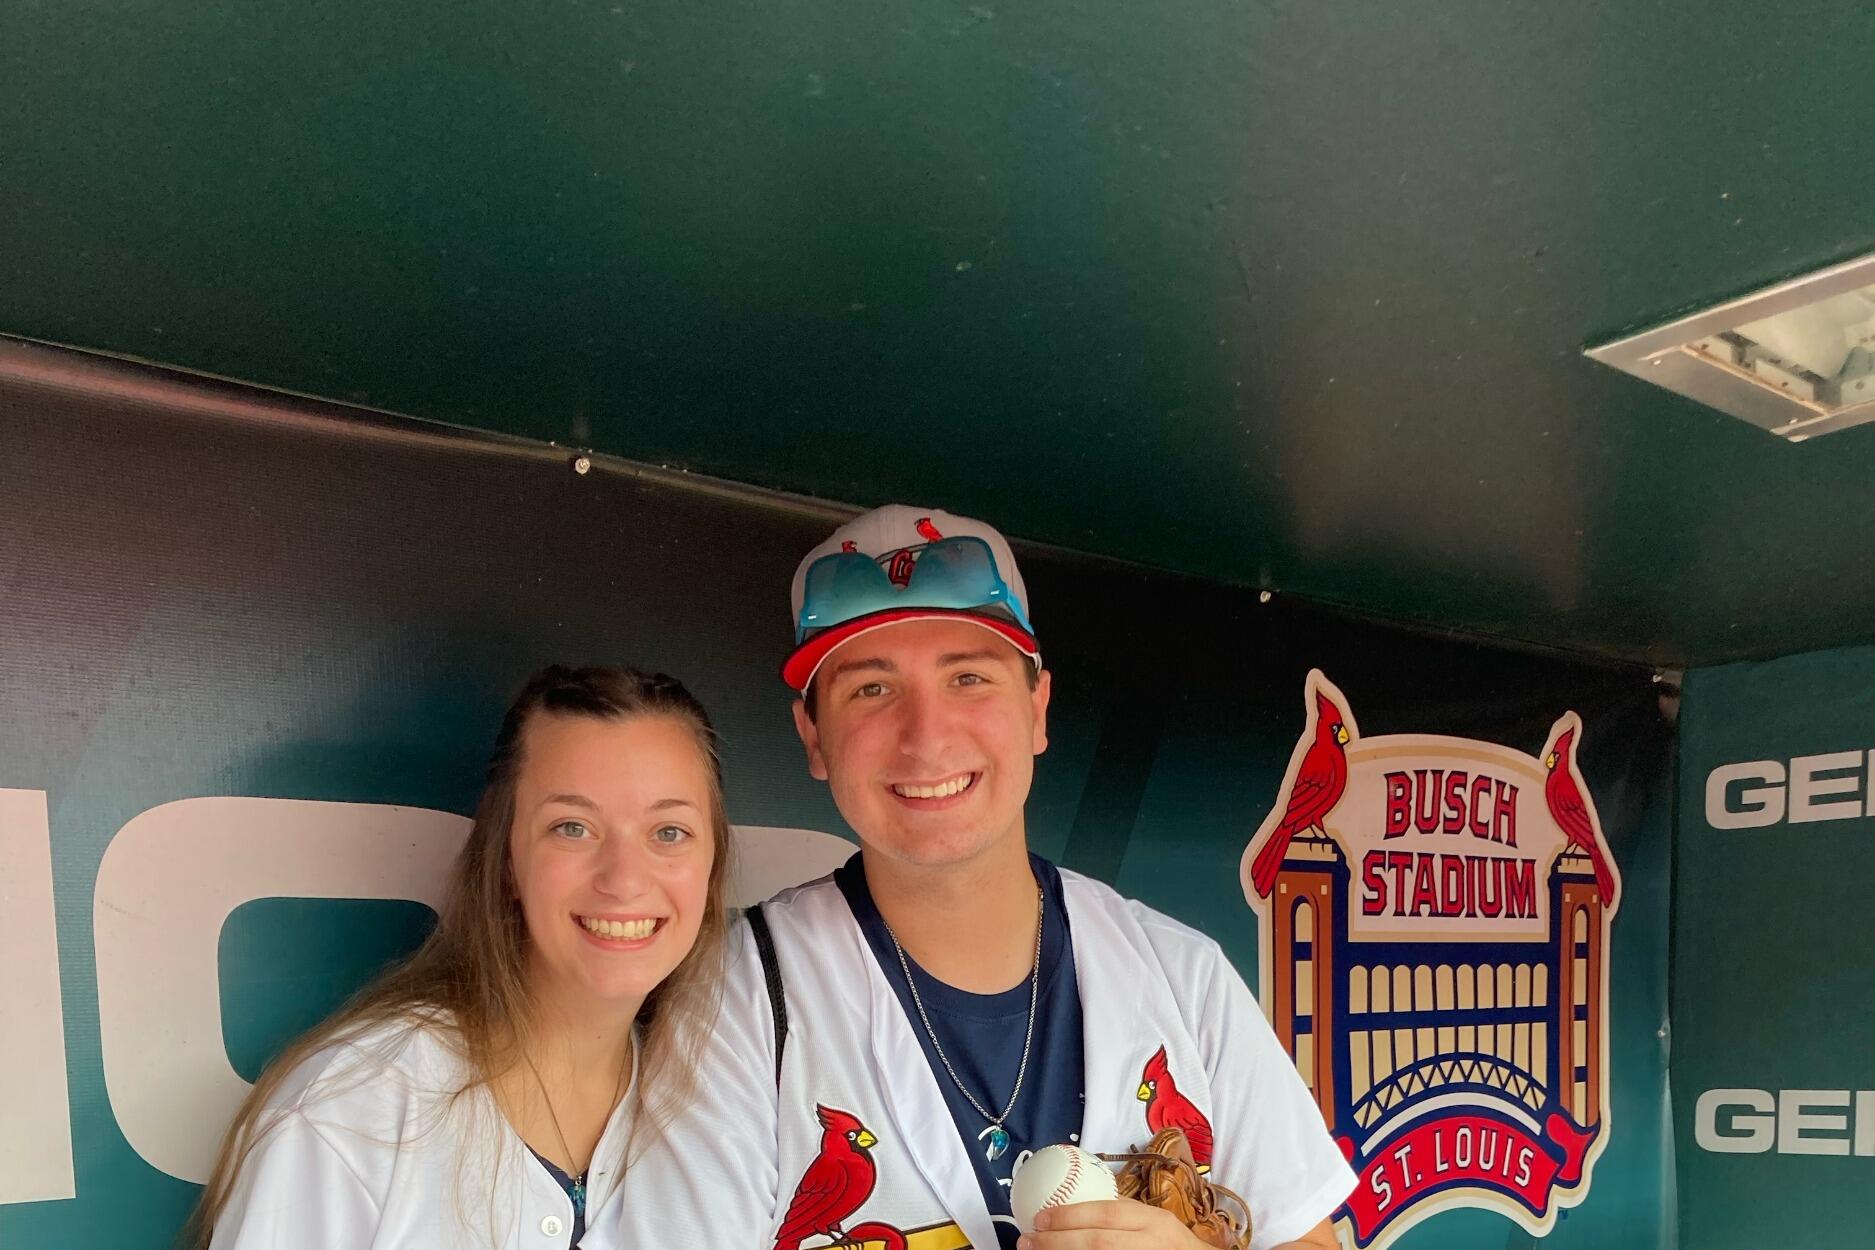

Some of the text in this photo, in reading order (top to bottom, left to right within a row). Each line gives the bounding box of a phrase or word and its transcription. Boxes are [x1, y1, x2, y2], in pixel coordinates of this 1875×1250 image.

[1383, 769, 1519, 849] BUSCH
[1362, 849, 1538, 919] STADIUM
[1371, 1124, 1535, 1212] ST. LOUIS
